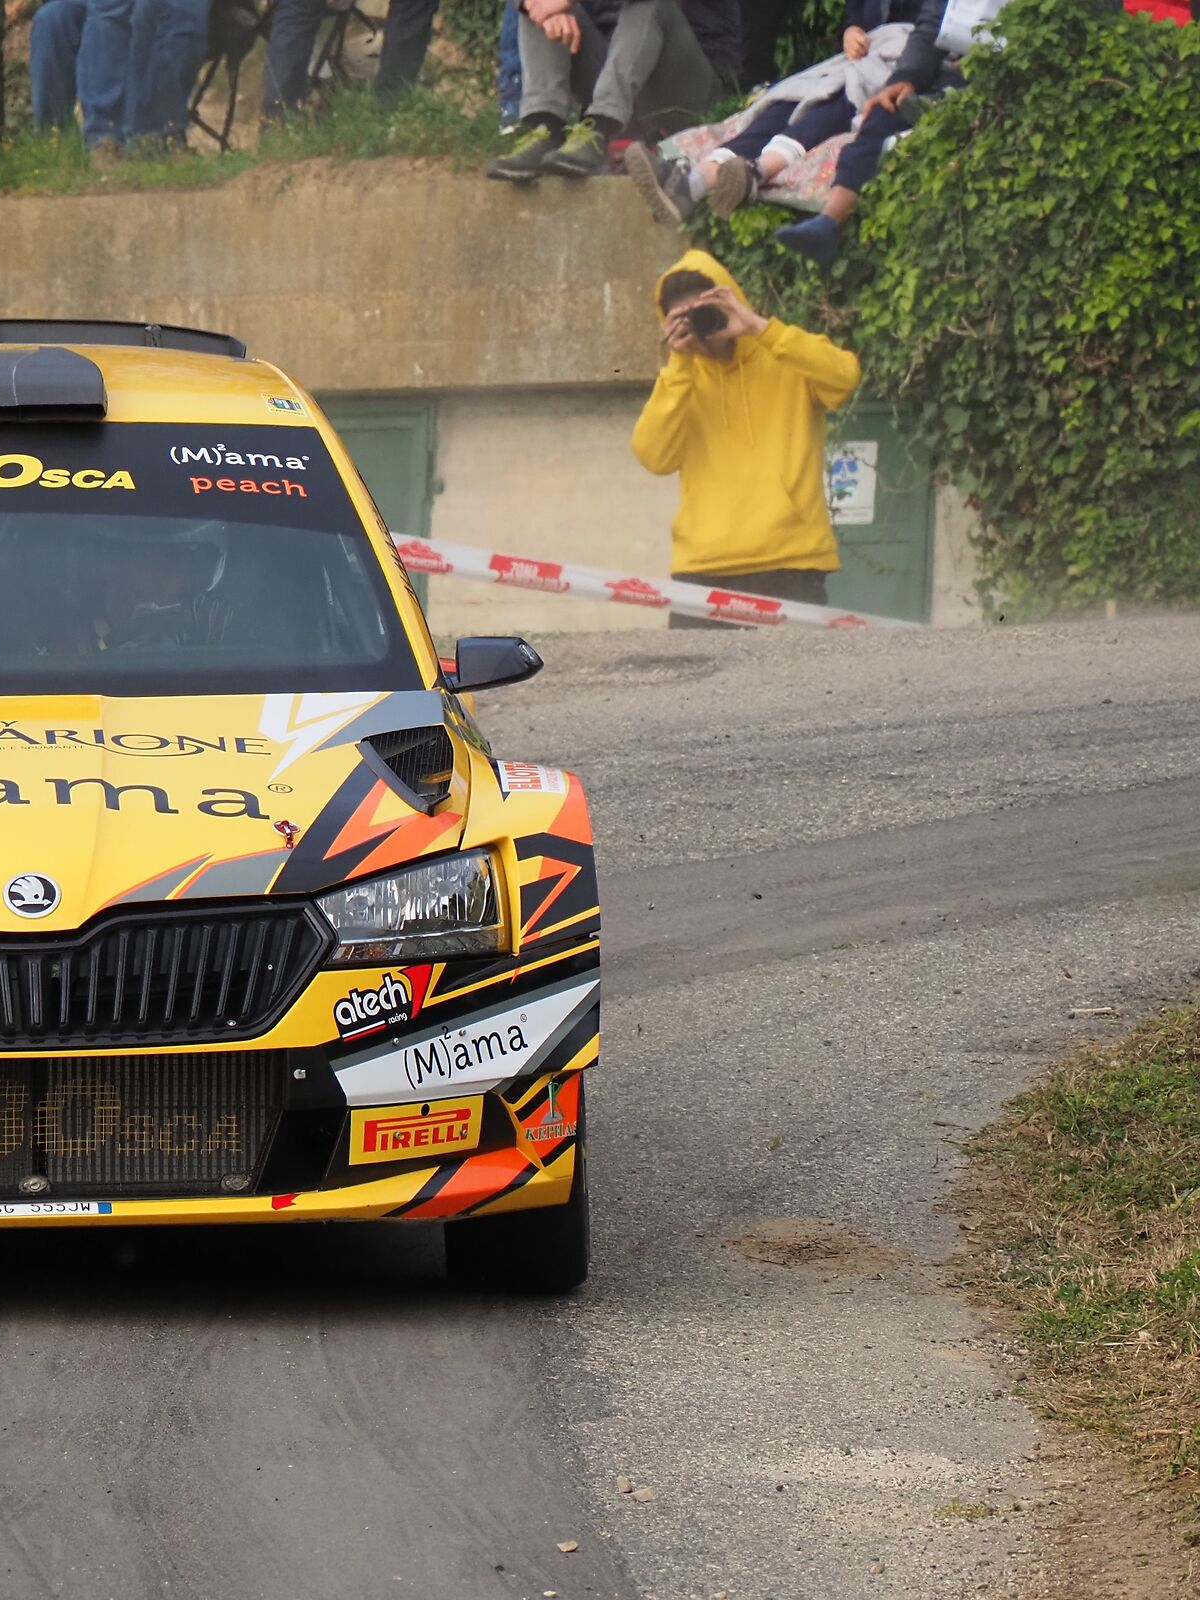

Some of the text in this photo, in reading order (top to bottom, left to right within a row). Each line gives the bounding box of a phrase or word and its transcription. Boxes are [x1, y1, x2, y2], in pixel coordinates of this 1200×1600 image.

[190, 475, 307, 497] peach
[335, 976, 408, 1027] atech
[388, 1011, 408, 1025] racing
[363, 1107, 472, 1152] PIRELLI
